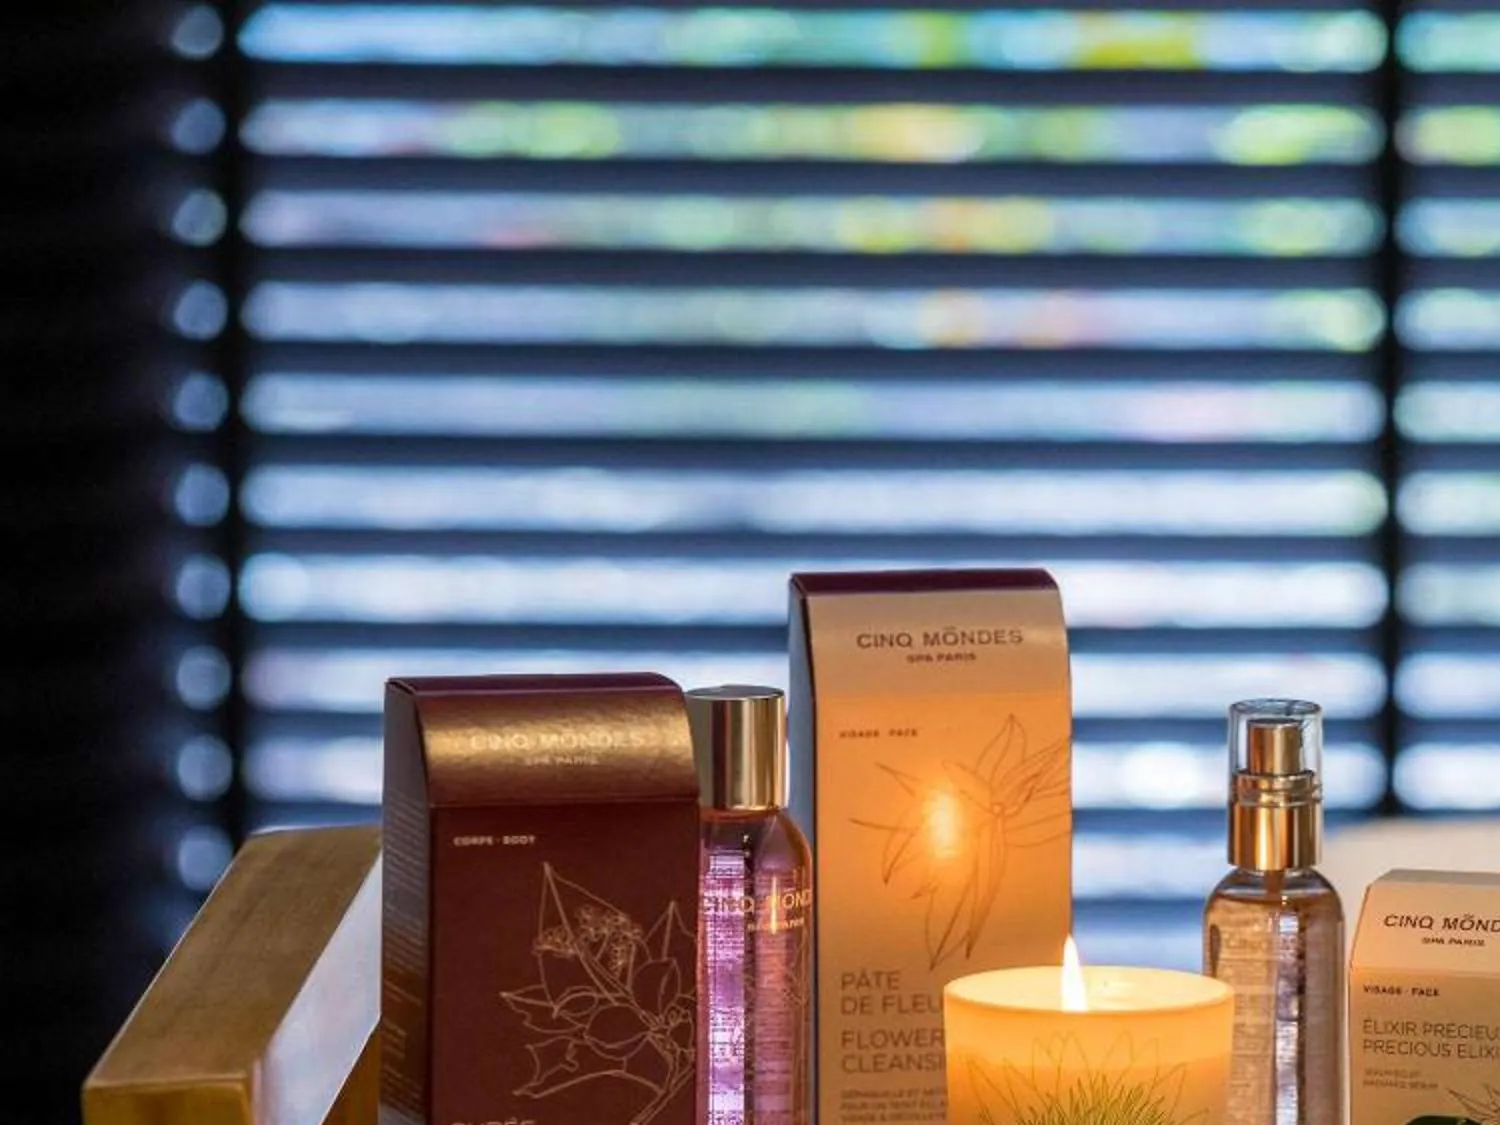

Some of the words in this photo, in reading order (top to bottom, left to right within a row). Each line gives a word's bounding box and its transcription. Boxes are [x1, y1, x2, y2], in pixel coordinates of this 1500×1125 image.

[856, 630, 913, 651] CINQ
[936, 651, 977, 663] PARIS
[1383, 914, 1434, 931] CINQ
[840, 996, 872, 1016] DE
[881, 992, 944, 1016] FLEU
